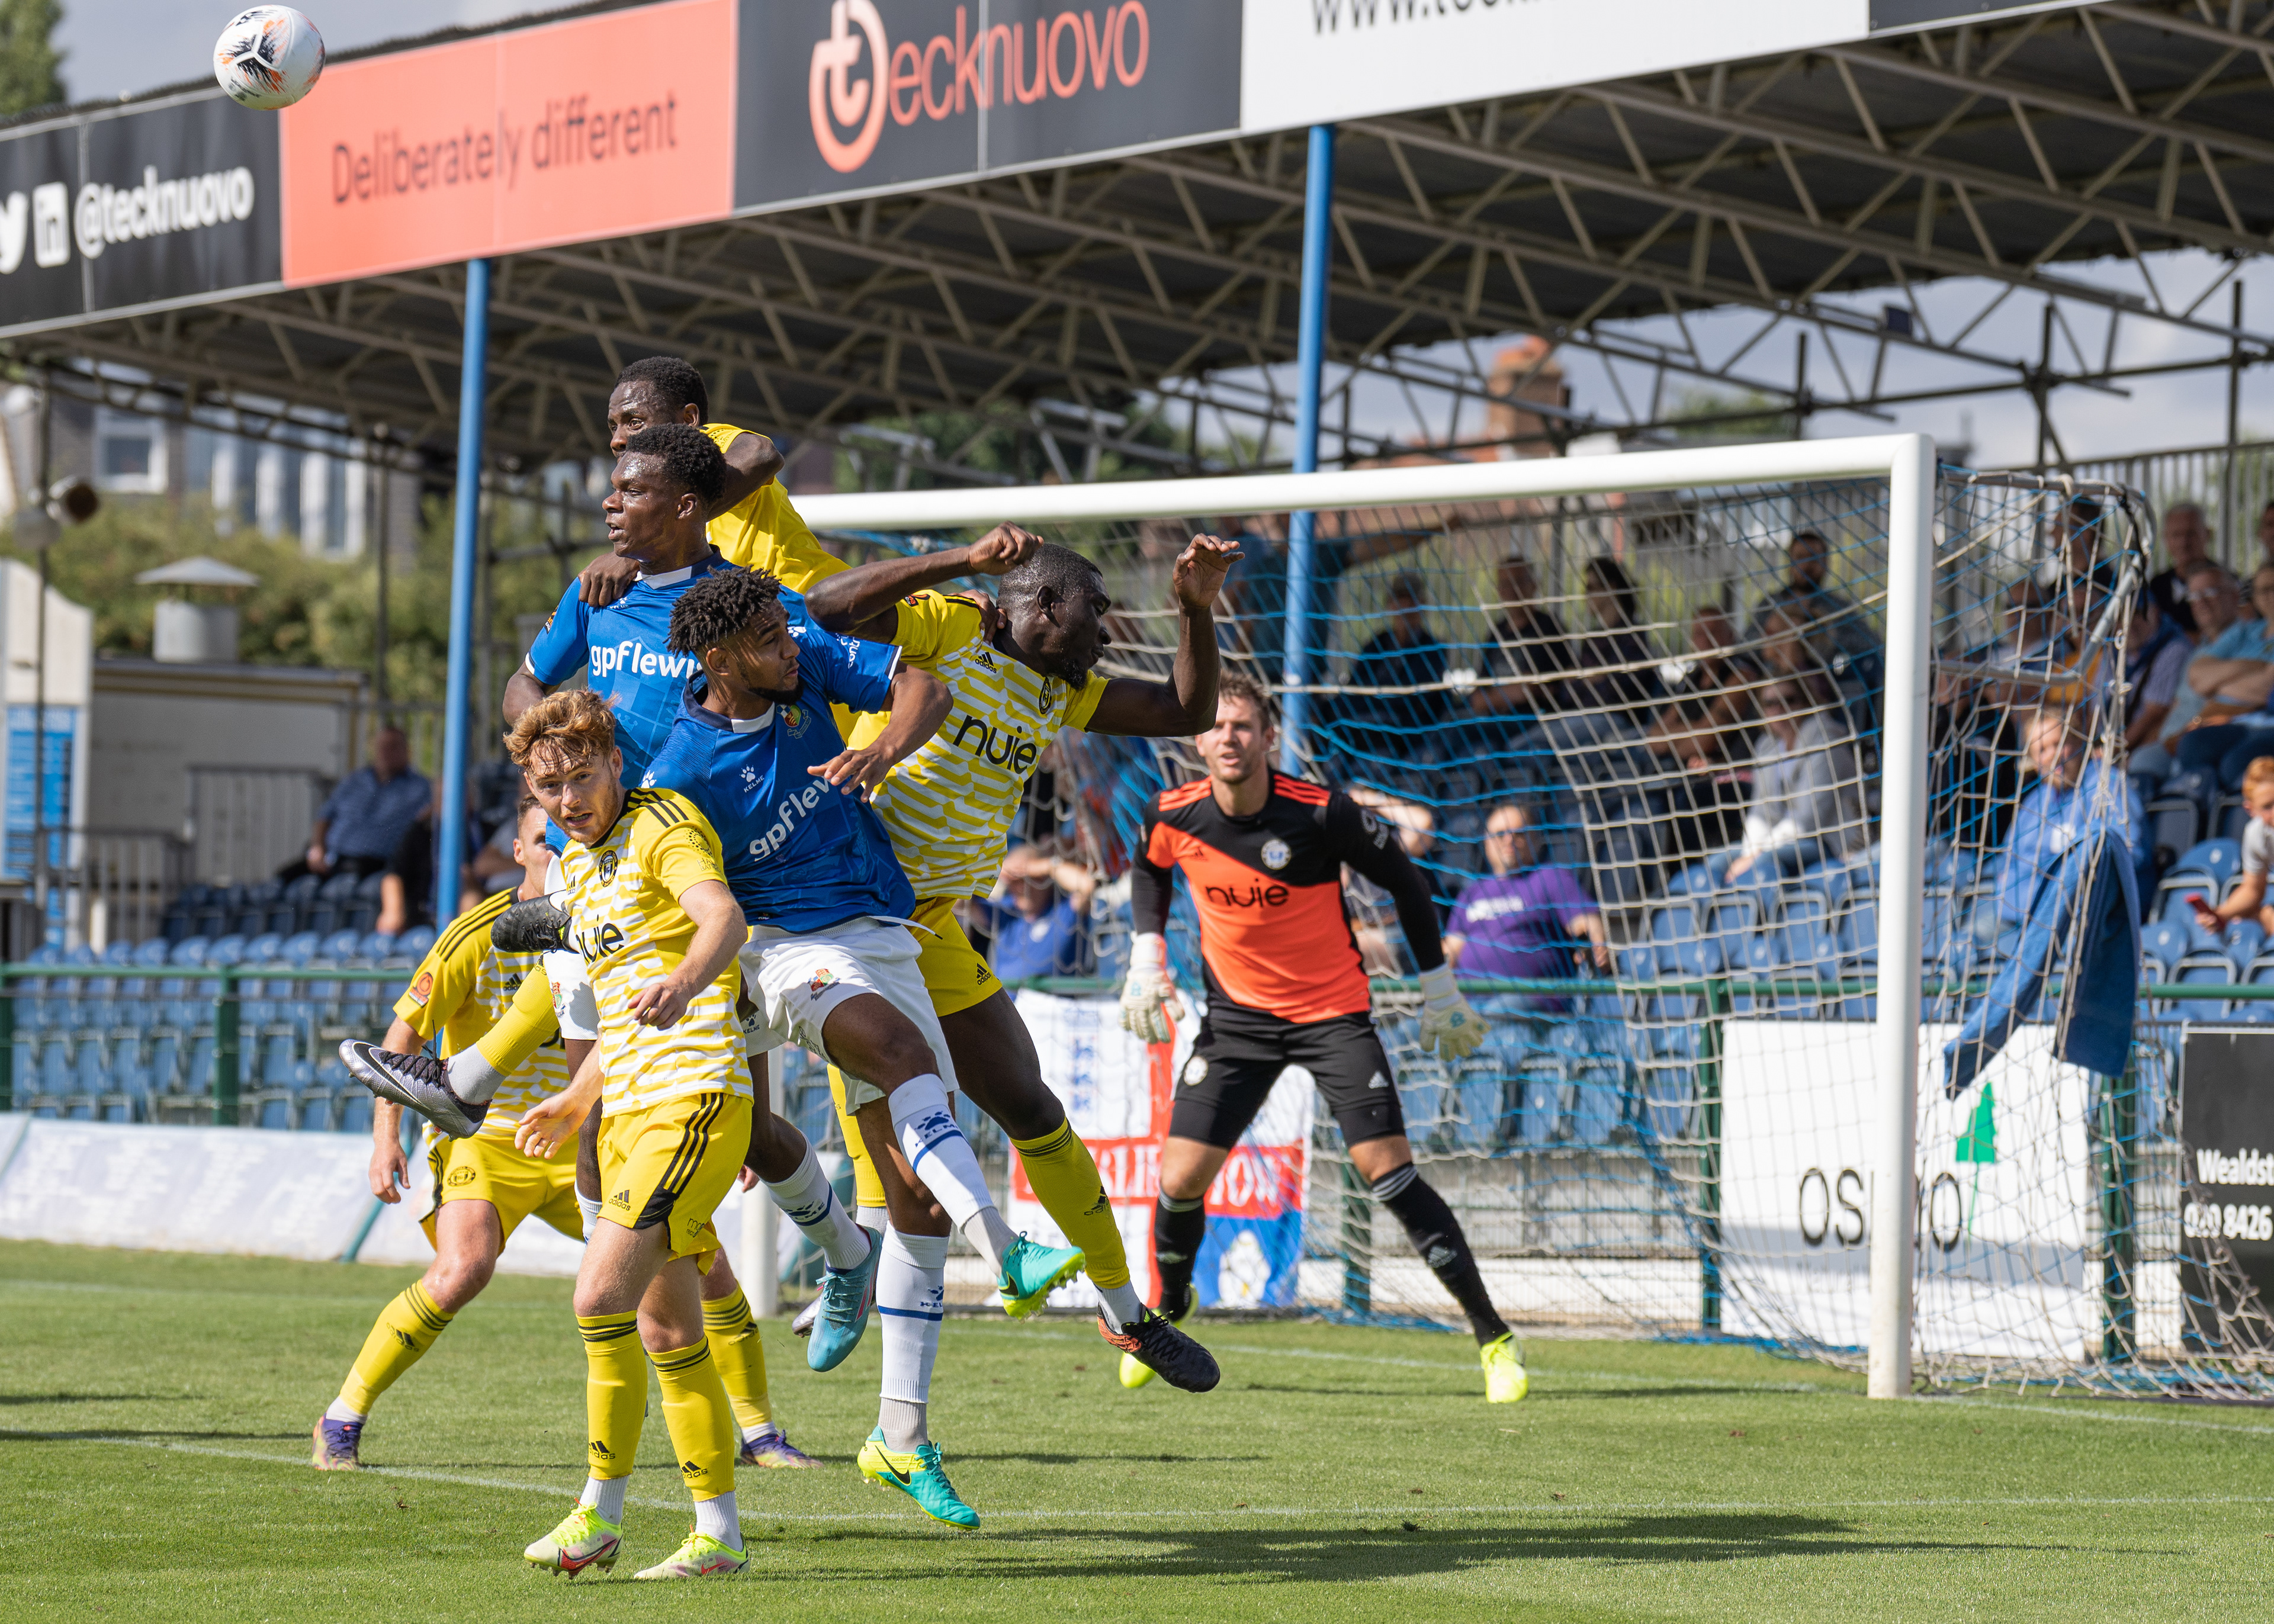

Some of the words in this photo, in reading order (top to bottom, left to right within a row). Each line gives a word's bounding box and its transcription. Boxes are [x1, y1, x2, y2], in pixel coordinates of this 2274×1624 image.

[331, 109, 522, 205] Deliberately
[532, 91, 676, 169] different
[74, 163, 255, 259] @tecknuovo
[975, 658, 997, 674] adidas
[952, 714, 1037, 774] nuie
[743, 774, 765, 793] KELME
[1206, 878, 1289, 908] nuie
[977, 972, 992, 986] adidas
[743, 1024, 760, 1034] KELME
[608, 1198, 631, 1211] adidas
[2222, 1203, 2273, 1241] 8426
